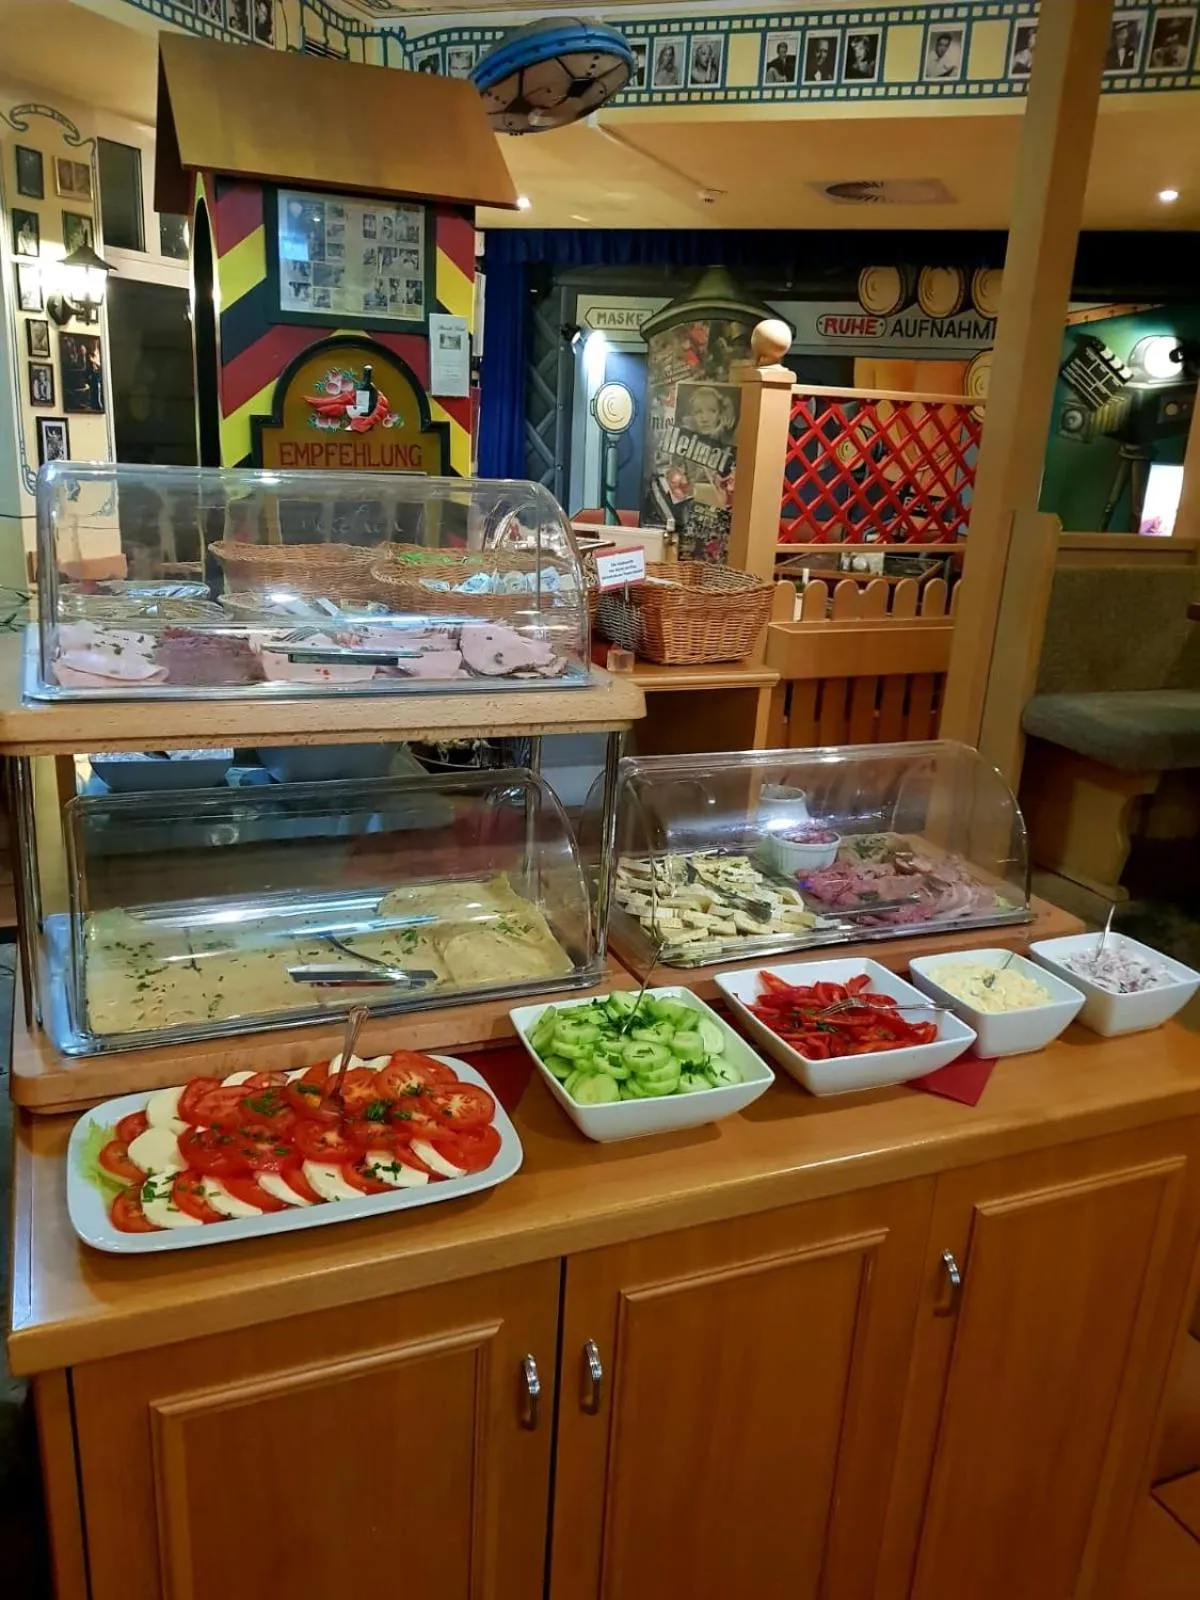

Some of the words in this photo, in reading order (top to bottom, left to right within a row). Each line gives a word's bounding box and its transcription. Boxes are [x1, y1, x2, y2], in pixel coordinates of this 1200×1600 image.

[596, 311, 644, 326] MASKE
[823, 317, 878, 336] RUHE
[890, 318, 997, 341] AUFNAHM
[279, 442, 422, 467] EMPFEHLUNG
